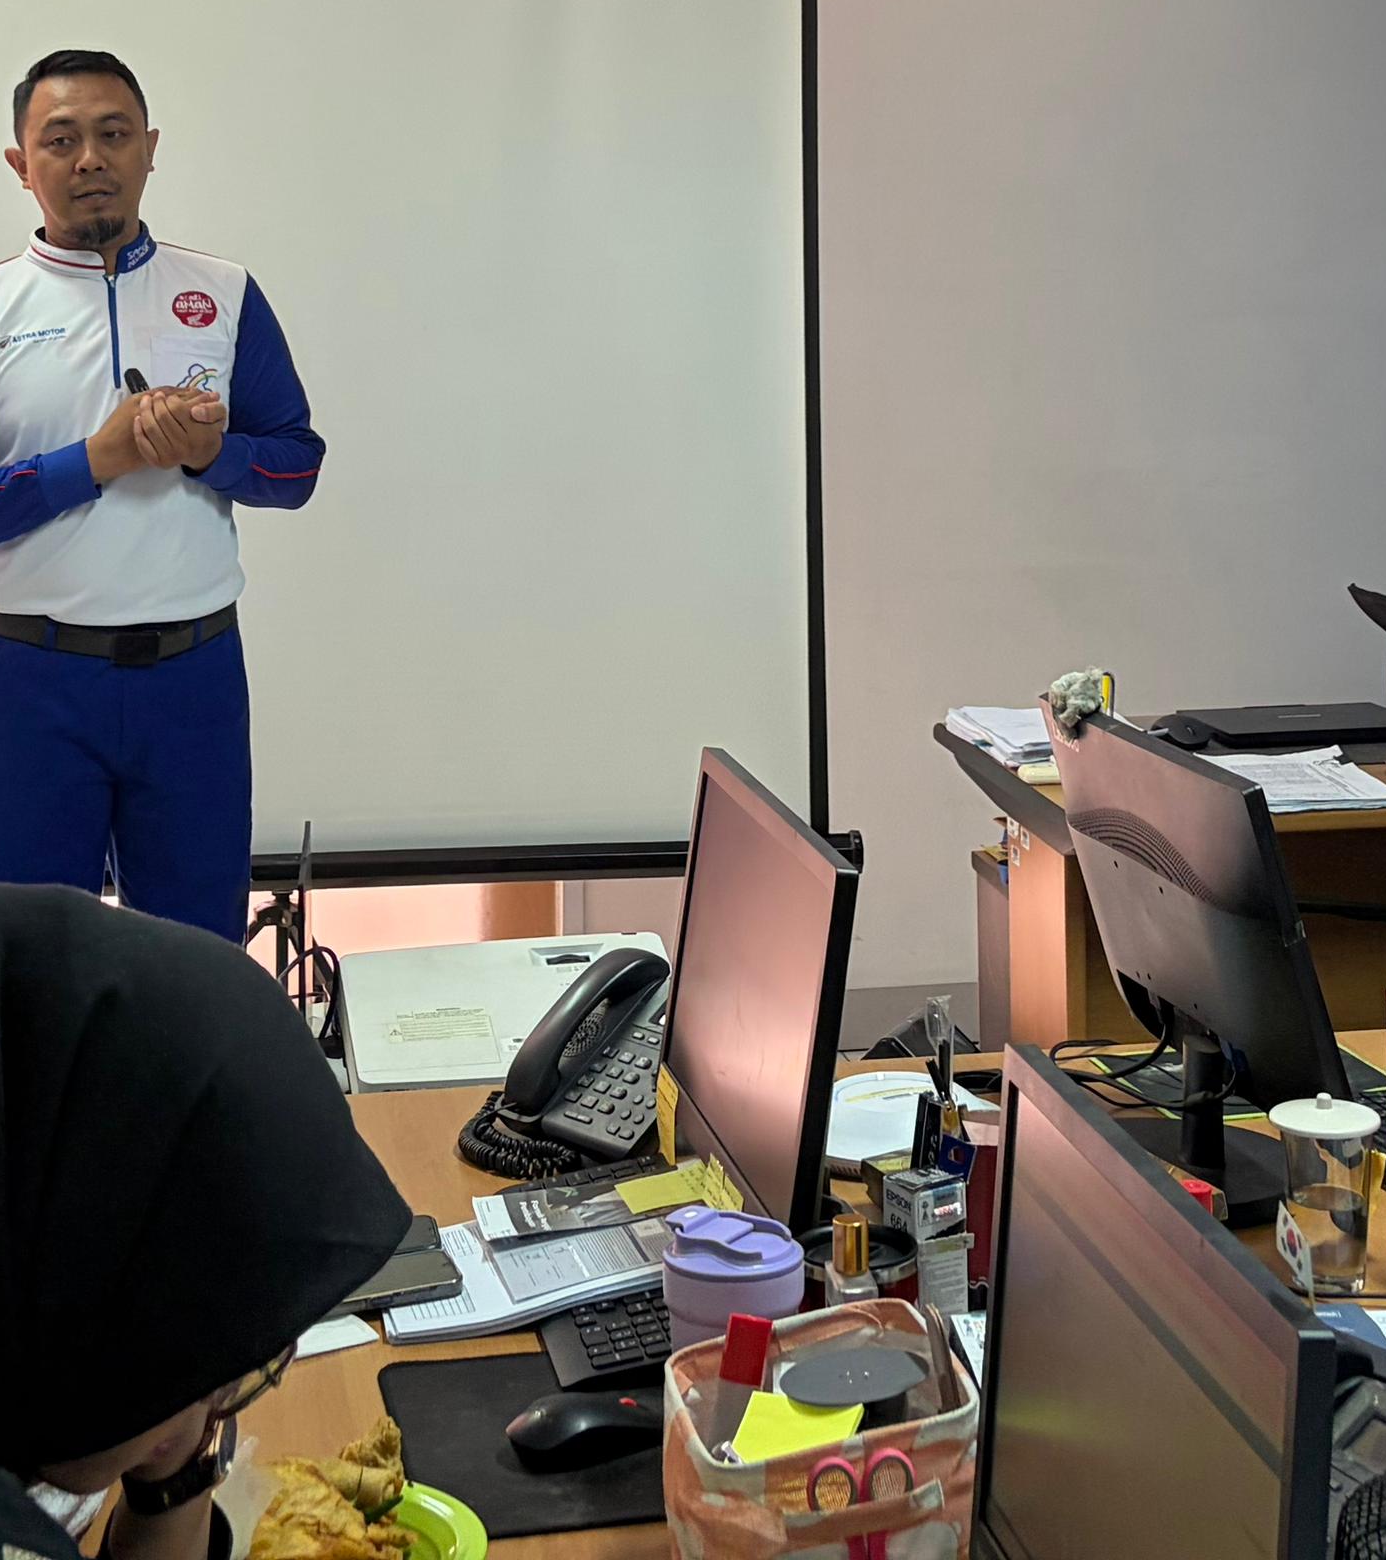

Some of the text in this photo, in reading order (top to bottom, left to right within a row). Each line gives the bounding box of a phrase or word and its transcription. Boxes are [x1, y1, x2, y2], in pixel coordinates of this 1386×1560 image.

[12, 332, 36, 343] ASTRA
[38, 327, 66, 336] MOTOR
[886, 1189, 912, 1212] EPSON
